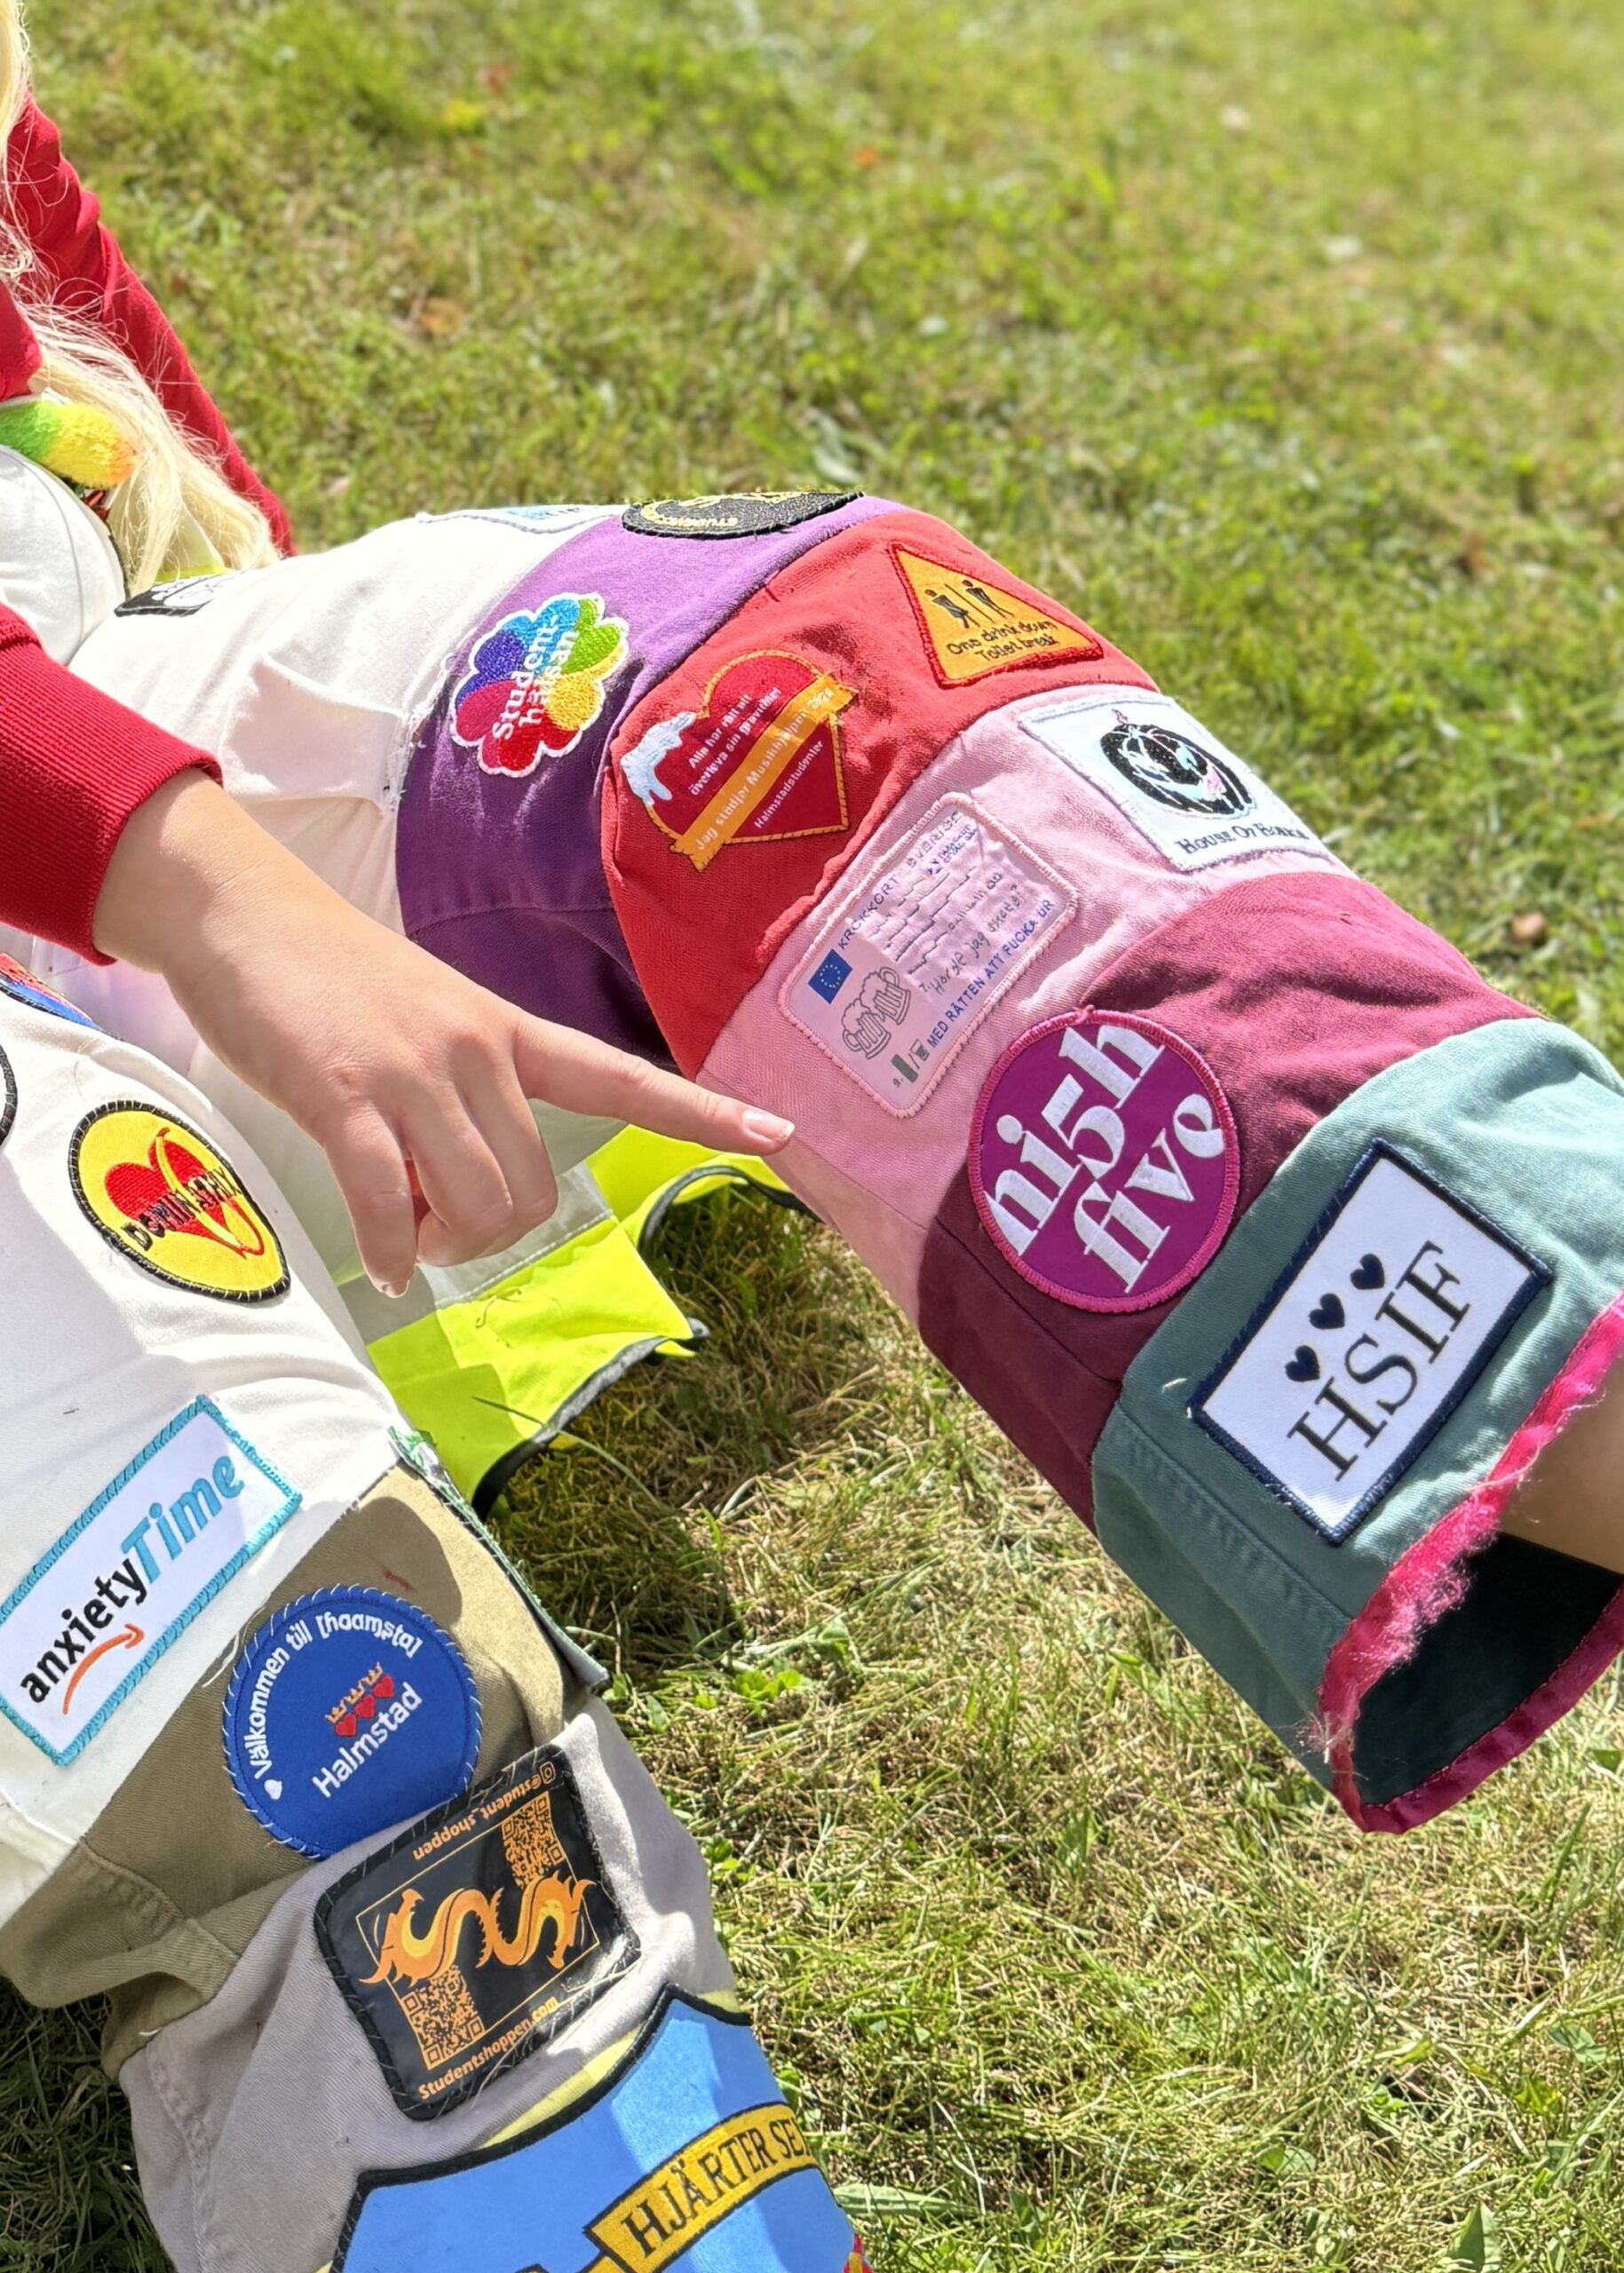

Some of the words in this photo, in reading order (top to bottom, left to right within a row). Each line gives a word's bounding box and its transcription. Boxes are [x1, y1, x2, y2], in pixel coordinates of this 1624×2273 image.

[946, 639, 981, 654] One
[981, 624, 1018, 642] drink
[974, 640, 1023, 661] Toilet
[727, 733, 741, 752] sin
[696, 828, 718, 851] Jag
[927, 1021, 948, 1048] MED
[946, 978, 986, 1019] RÄTTEN
[984, 954, 1004, 980] ATT
[1073, 1093, 1225, 1294] five
[1287, 1240, 1471, 1482] HSIF
[20, 1455, 245, 1703] anxietyTime
[244, 1647, 290, 1779] Välkommen
[286, 1620, 313, 1651] till
[312, 1682, 424, 1798] Halmstad
[418, 1996, 560, 2101] Studentshoppen.com
[620, 2127, 778, 2259] HJÄRTER
